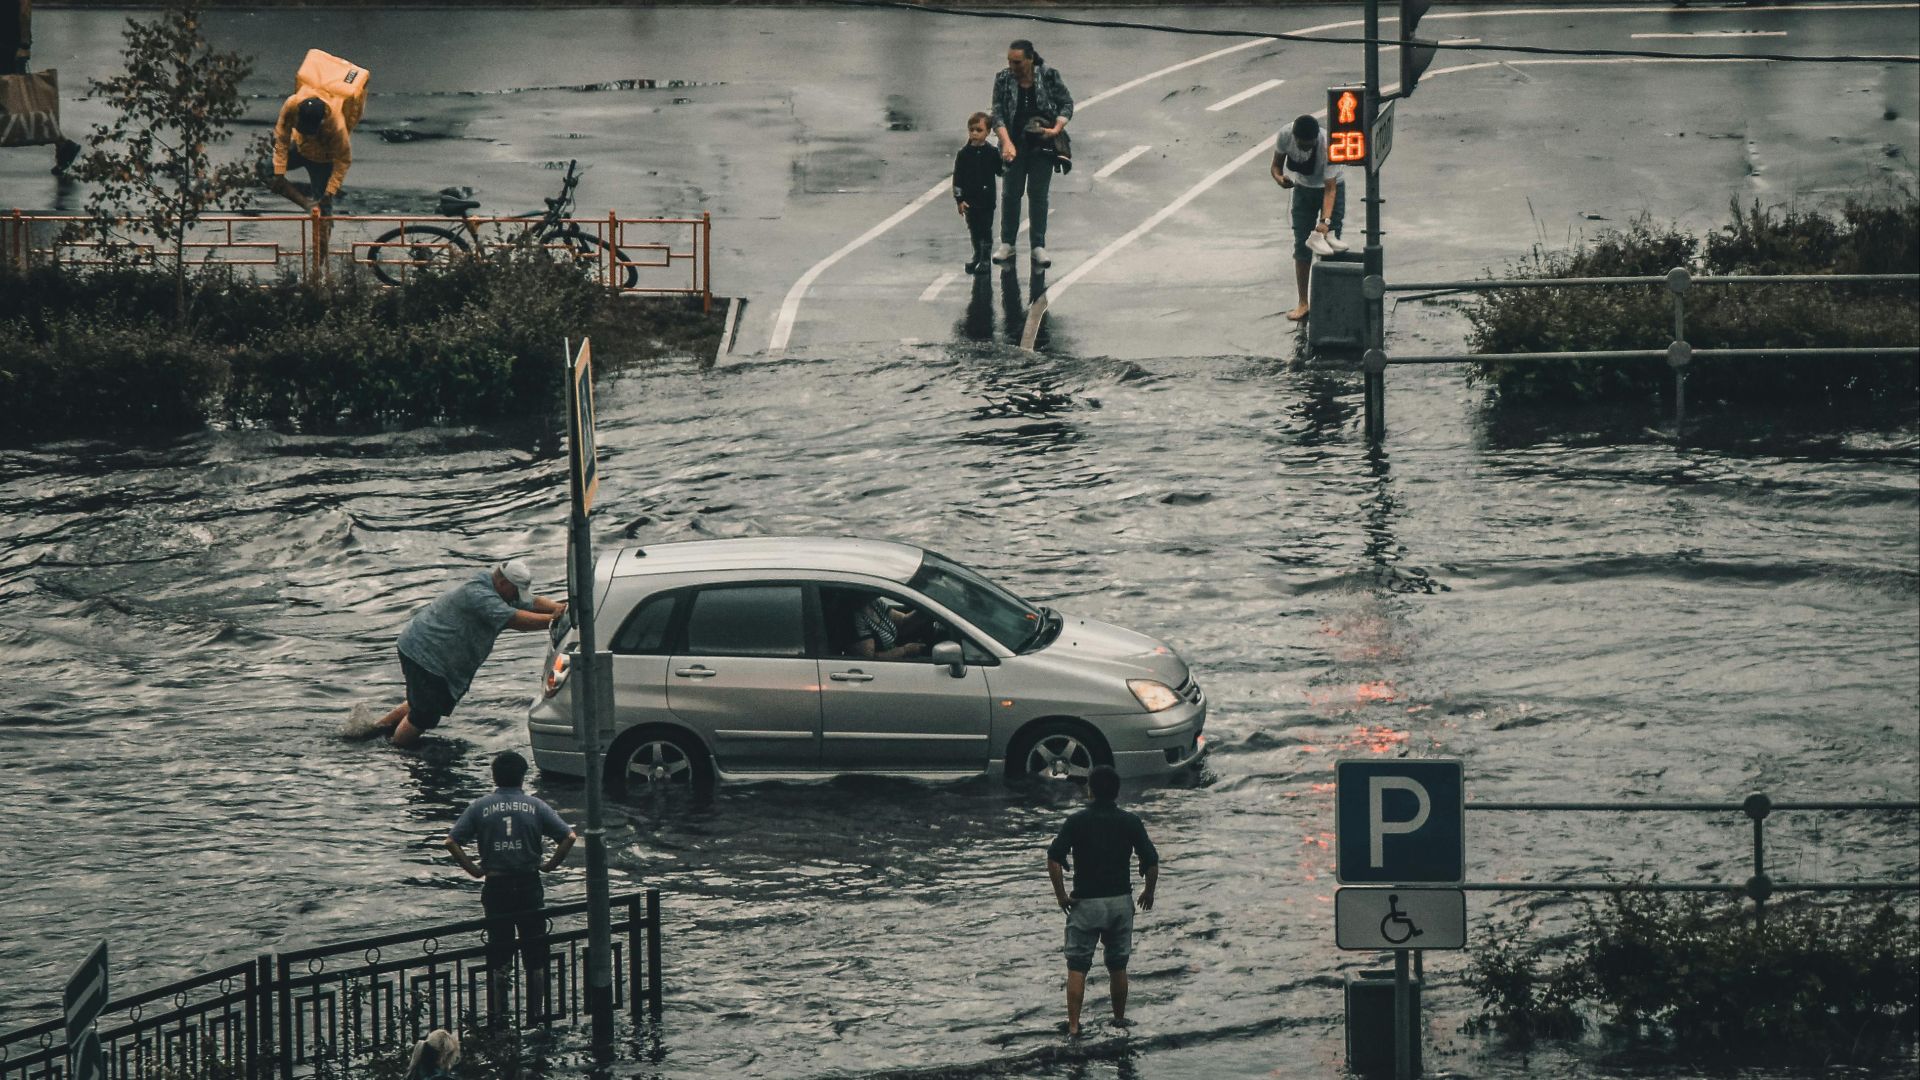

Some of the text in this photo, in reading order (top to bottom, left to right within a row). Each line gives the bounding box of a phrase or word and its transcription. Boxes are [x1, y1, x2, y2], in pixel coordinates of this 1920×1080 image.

[1329, 131, 1365, 161] 28
[482, 802, 536, 817] DIMENSION
[502, 816, 512, 836] 1
[1369, 776, 1431, 868] P
[494, 840, 522, 851] SPAS
